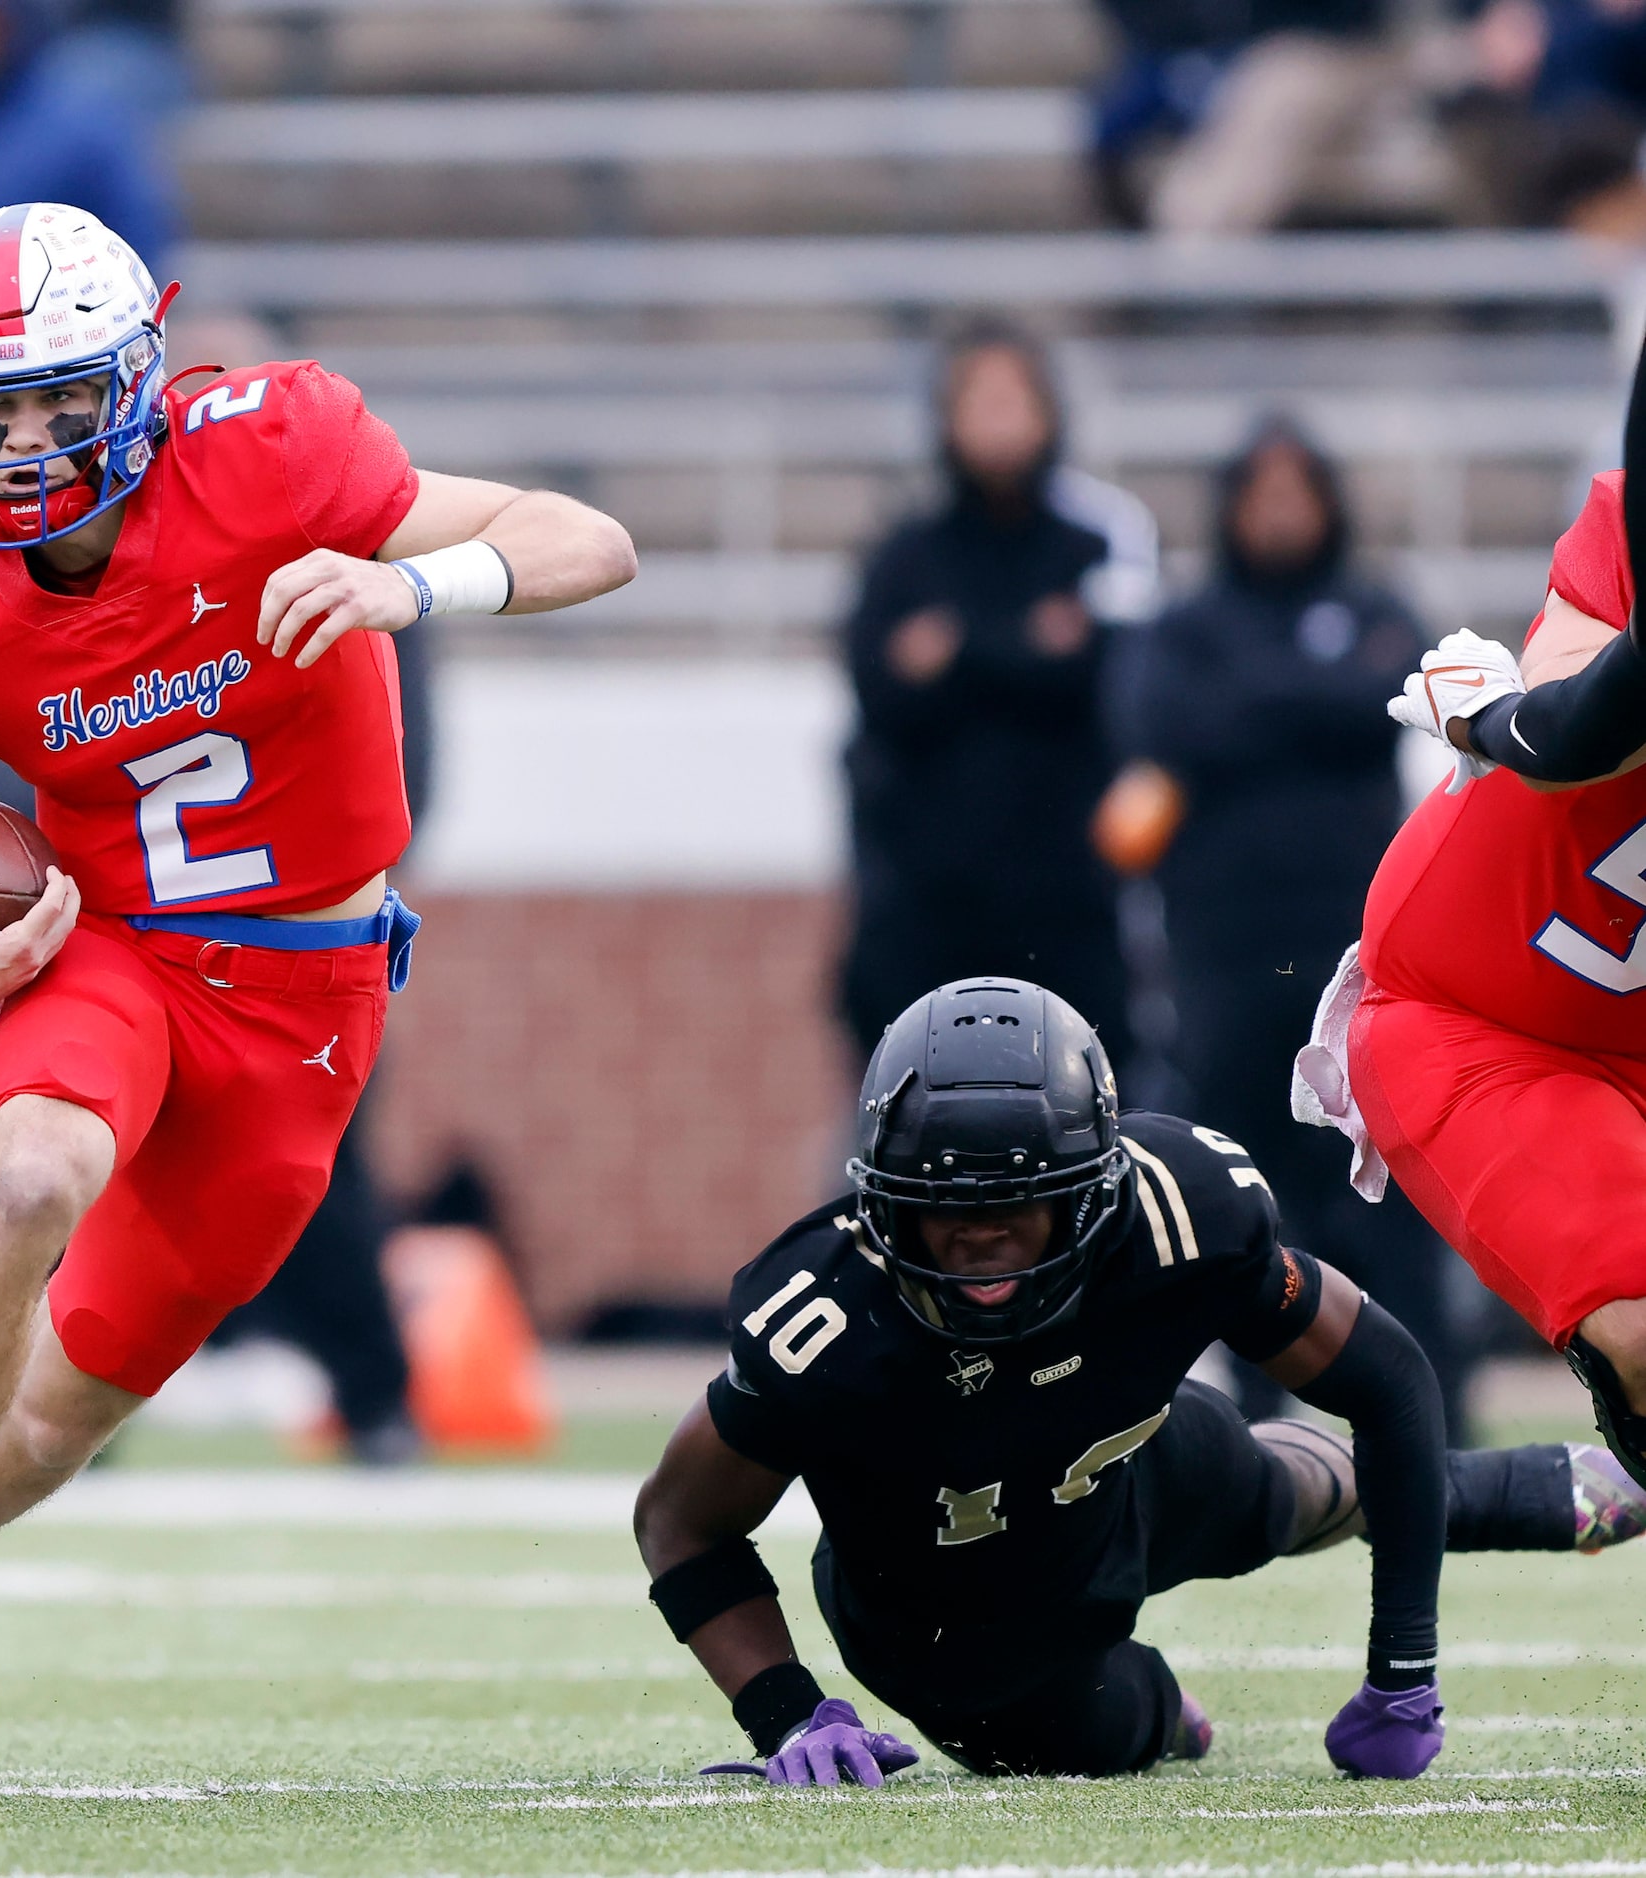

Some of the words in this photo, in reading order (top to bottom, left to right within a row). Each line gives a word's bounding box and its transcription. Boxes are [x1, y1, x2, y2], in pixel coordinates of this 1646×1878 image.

[49, 288, 68, 299] HUNT
[42, 311, 69, 326] FIGHT
[49, 334, 74, 349] FIGHT
[85, 328, 107, 341] FIGHT
[184, 376, 271, 435] 2
[38, 650, 251, 751] Heritage
[118, 729, 282, 908] 2
[742, 1270, 848, 1375] 10
[1036, 1359, 1080, 1383] BATTLE
